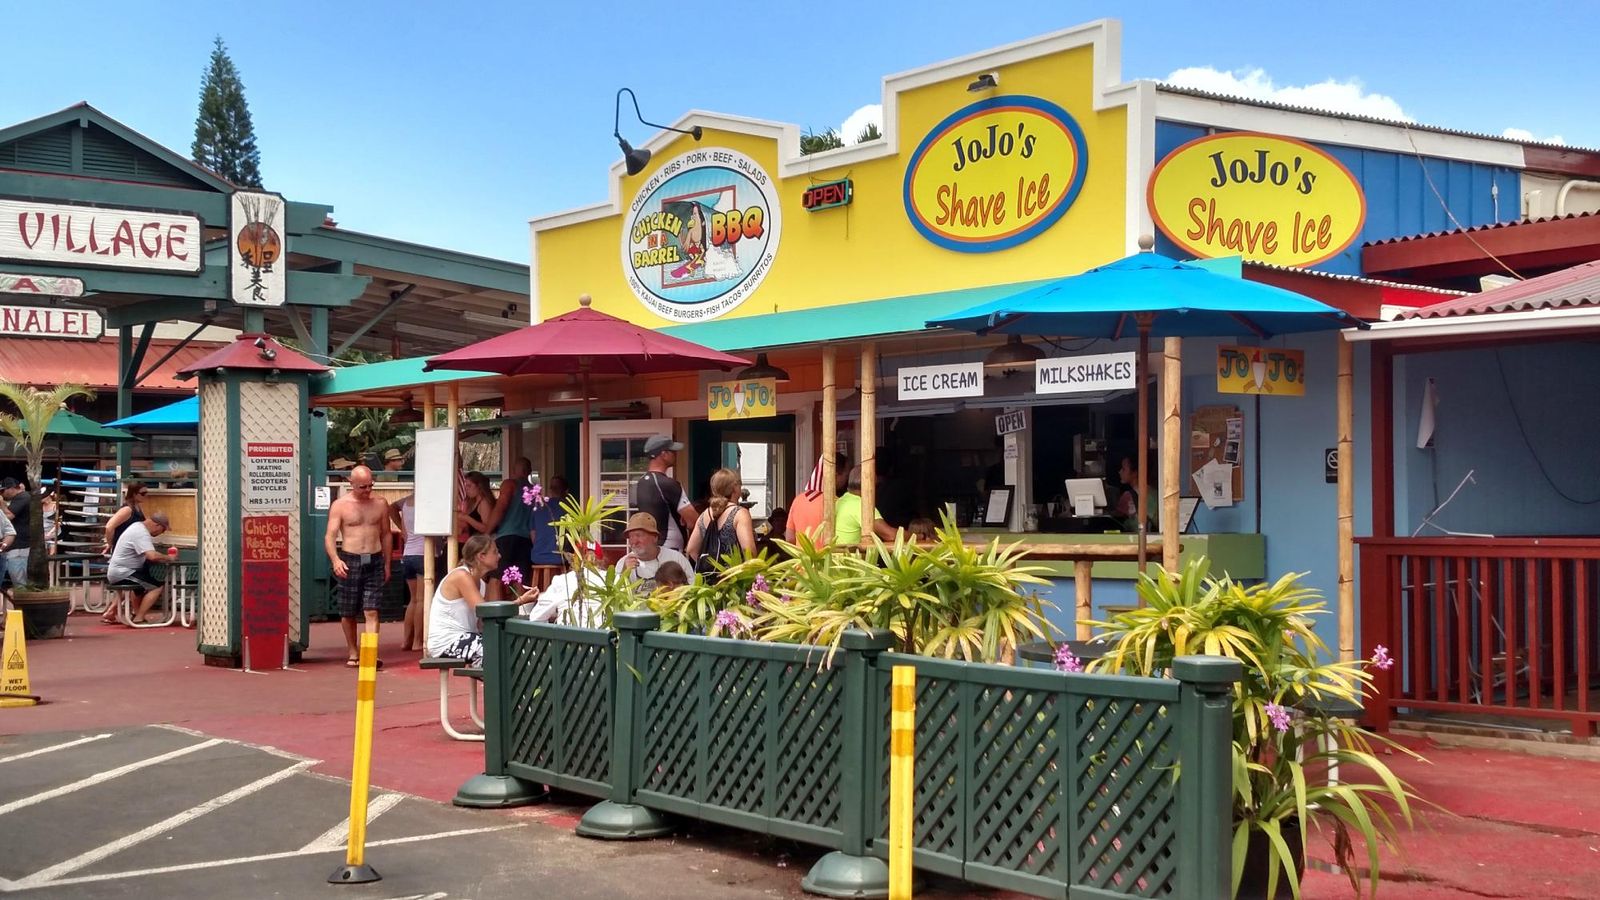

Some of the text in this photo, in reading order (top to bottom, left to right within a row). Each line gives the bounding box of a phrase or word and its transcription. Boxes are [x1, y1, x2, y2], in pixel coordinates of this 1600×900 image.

[951, 122, 1037, 172] JoJo's
[631, 151, 767, 212] CHICKEN RIBS PORK BEEF SALADS
[1208, 149, 1317, 195] JoJo's
[802, 183, 845, 208] OPEN
[935, 173, 1051, 228] Shave Ice
[18, 212, 189, 261] VILLAGE
[647, 233, 659, 249] IN
[711, 206, 765, 247] BBQ
[1186, 197, 1332, 255] Shave Ice
[633, 245, 681, 270] BARREL
[641, 289, 658, 308] KAUAI
[657, 303, 673, 314] BEEF
[673, 308, 704, 319] BURGERS
[706, 304, 721, 314] FISH
[722, 289, 742, 308] TACOS
[743, 252, 773, 292] BURRITOS
[0, 307, 90, 336] NALEI
[903, 371, 979, 392] ICE CREAM
[1039, 361, 1132, 385] MILKSHAKES
[998, 412, 1025, 433] OPEN
